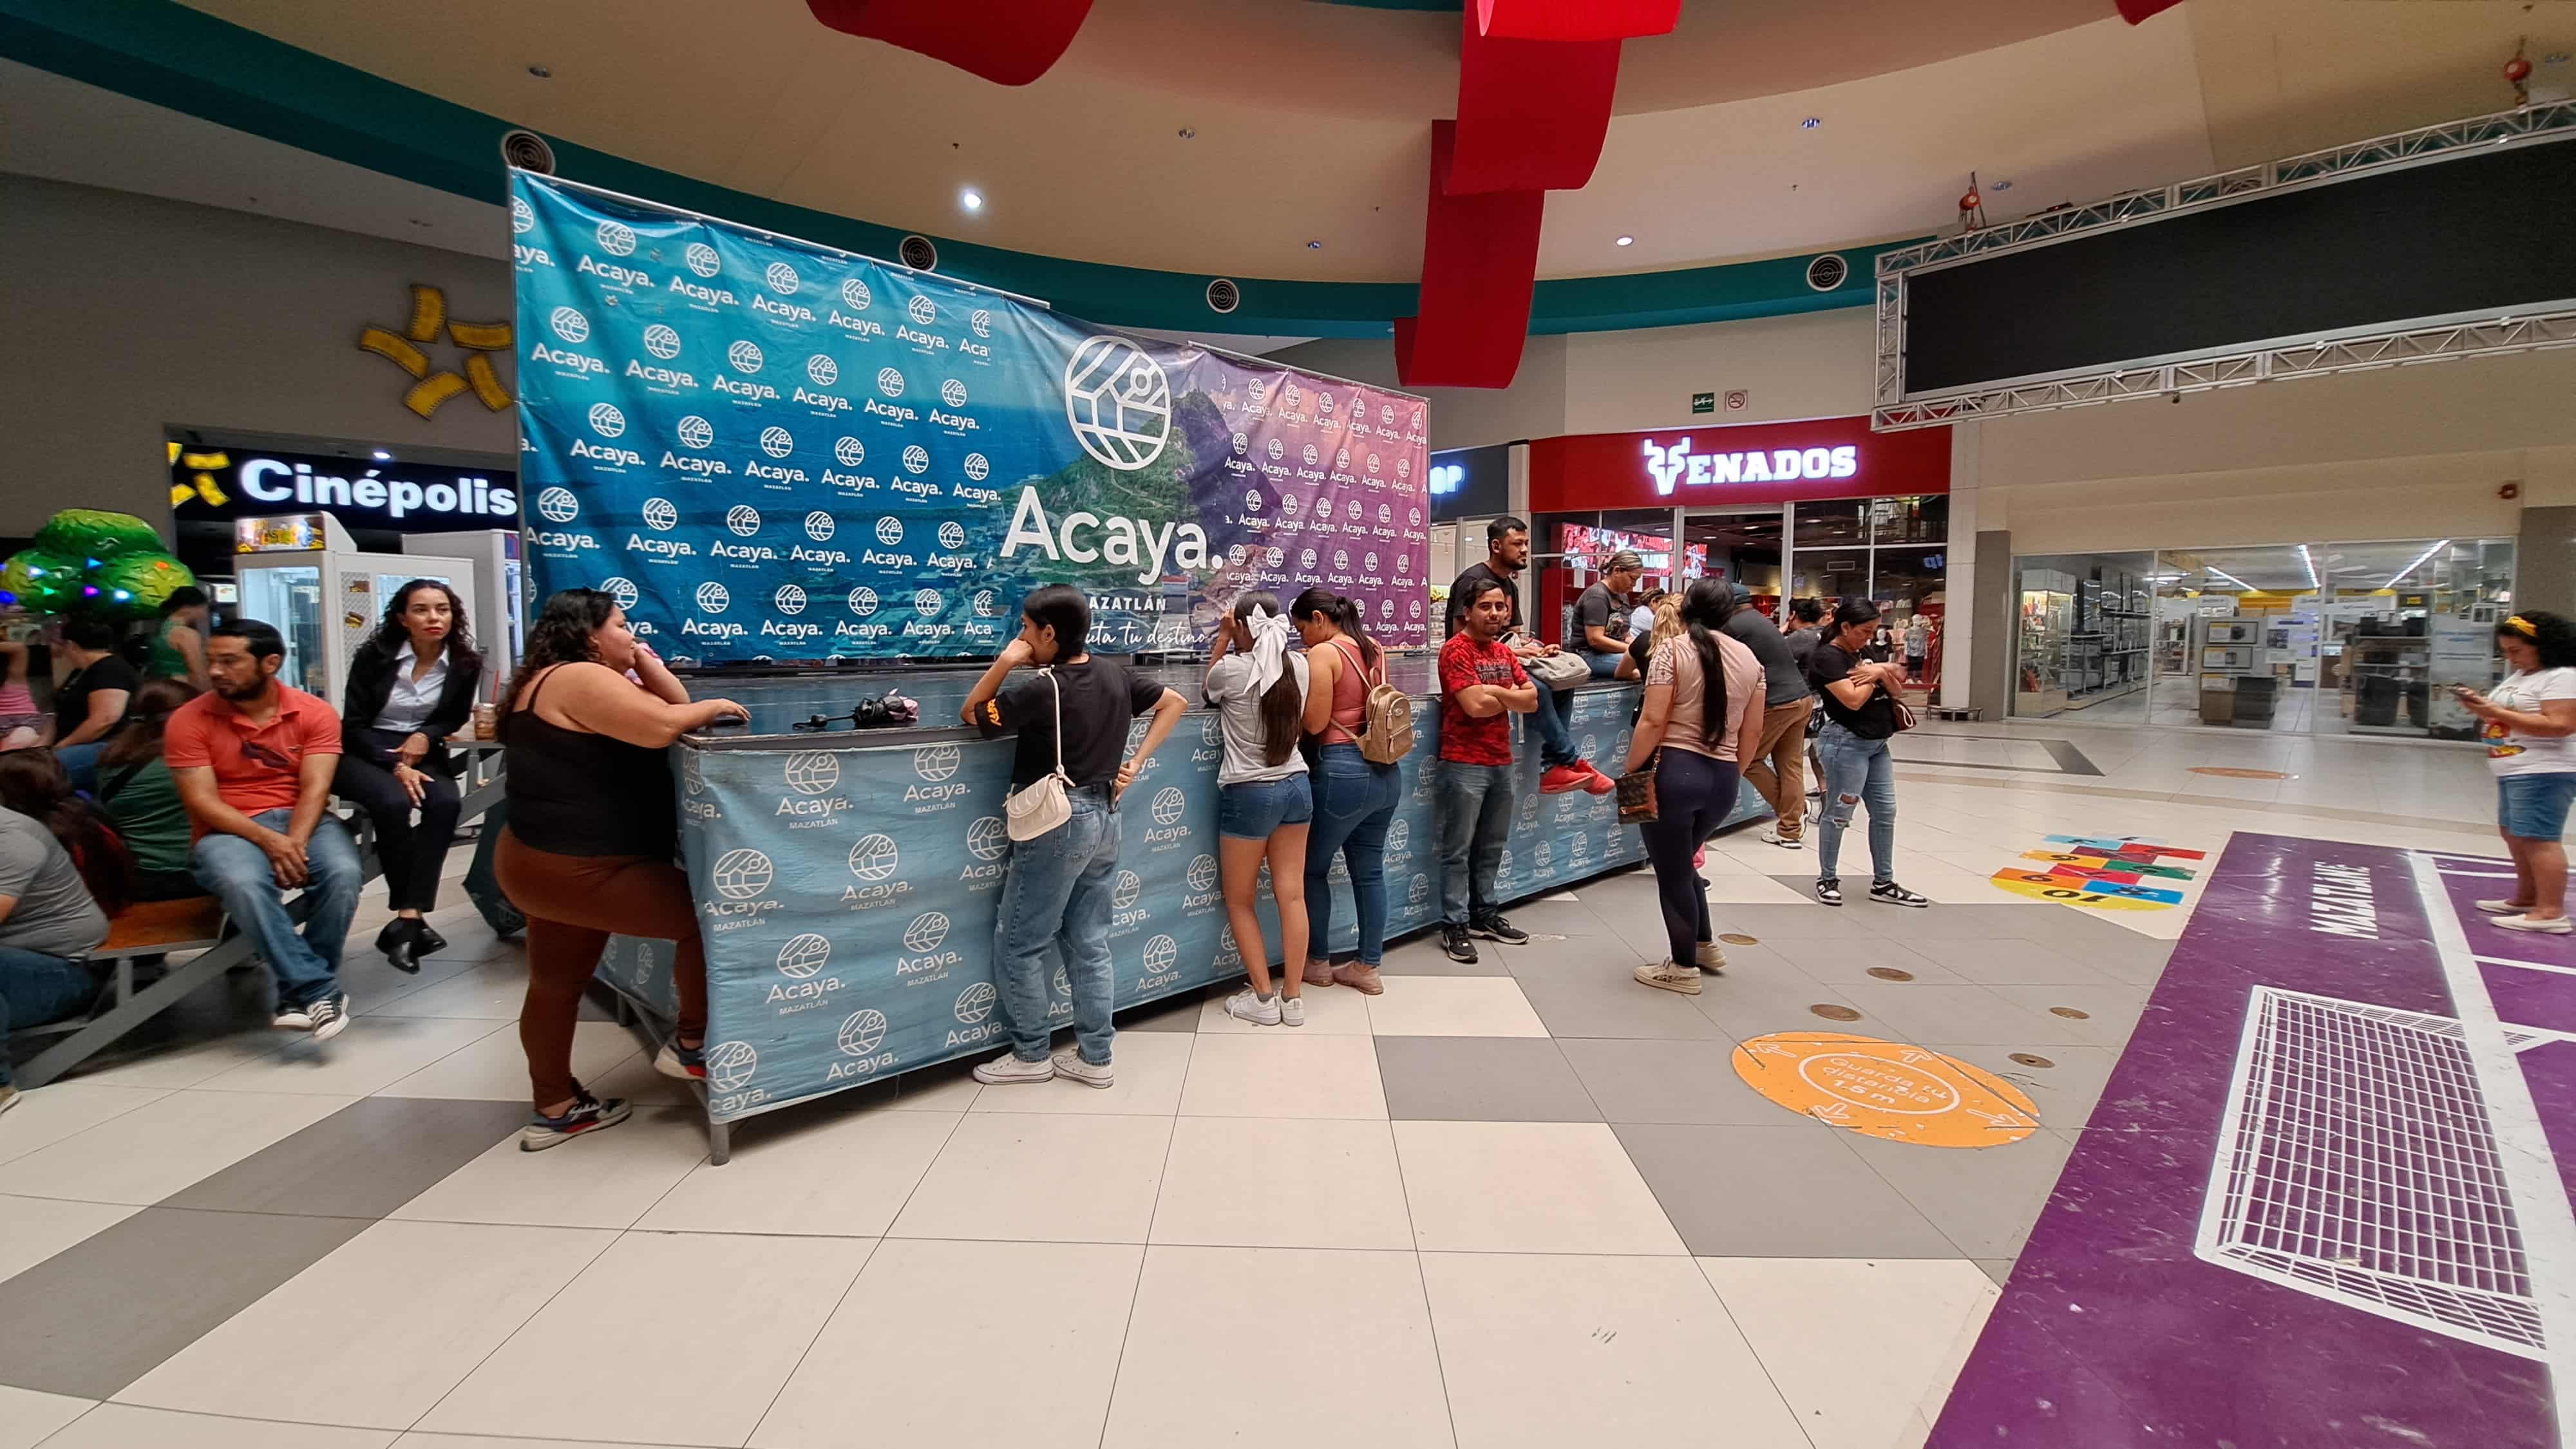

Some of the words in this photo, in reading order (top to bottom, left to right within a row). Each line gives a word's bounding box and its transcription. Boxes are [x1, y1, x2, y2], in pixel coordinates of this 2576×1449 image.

[577, 254, 655, 287] Acaya.
[670, 276, 739, 306] Acaya.
[752, 294, 817, 321] Acaya.
[828, 310, 885, 336] Acaya.
[896, 325, 949, 349] Acaya.
[532, 343, 611, 374] Acaya.
[959, 338, 989, 361] Aca
[626, 359, 699, 388] Acaya.
[712, 375, 781, 400] Acaya.
[793, 386, 853, 411] Acaya.
[864, 398, 918, 421] Acaya.
[1242, 402, 1272, 417] Acaya.
[1279, 408, 1308, 423] Acaya.
[929, 409, 980, 430] Acaya.
[1313, 414, 1341, 428] Acaya.
[1376, 426, 1400, 439] Acaya.
[570, 439, 646, 466] Acaya.
[660, 451, 732, 476] Acaya.
[744, 460, 810, 484] Acaya.
[1225, 457, 1255, 473] Acaya.
[1262, 461, 1291, 477] Acaya.
[1644, 437, 1856, 496] VENADOS
[822, 469, 880, 490] Acaya.
[1297, 467, 1327, 481] Acaya.
[1330, 471, 1356, 485] Acaya.
[1361, 476, 1386, 489] Acaya.
[240, 459, 518, 516] Cinépolis
[891, 476, 943, 496] Acaya.
[953, 483, 1001, 502] Acaya.
[1392, 482, 1415, 493] Acaya.
[1239, 514, 1270, 529] Acaya.
[1275, 518, 1305, 531] Acaya.
[1310, 520, 1337, 534] Acaya.
[1342, 524, 1368, 535] Acaya.
[999, 486, 1223, 585] Acaya.
[1372, 527, 1396, 538] Acaya.
[1403, 529, 1426, 541] Acaya.
[626, 534, 697, 556] Acaya.
[710, 540, 777, 562] Acaya.
[790, 545, 850, 565] Acaya.
[862, 549, 917, 568] Acaya.
[927, 553, 977, 571] Acaya.
[1260, 571, 1288, 583] Acaya.
[1295, 572, 1323, 585] Acaya.
[1328, 573, 1354, 585] Acaya.
[1359, 574, 1383, 586] Acaya.
[1392, 576, 1414, 588] Acaya.
[682, 618, 748, 638] Acaya.
[761, 620, 822, 638] Acaya.
[835, 620, 892, 639] Acaya.
[903, 621, 954, 638] Acaya.
[965, 621, 993, 638] Aca
[1147, 621, 1208, 645] destino
[1376, 621, 1399, 633] Acaya.
[1404, 621, 1426, 632] Acaya.
[904, 782, 971, 802] Acaya.
[775, 797, 854, 816] Acaya.
[1144, 824, 1191, 842] Acaya.
[960, 864, 1010, 880] Acay
[840, 881, 913, 901] Acaya.
[896, 952, 962, 975] Acaya.
[766, 978, 845, 1003] Acaya.
[1135, 973, 1182, 992] Acaya.
[944, 1023, 1007, 1048] Acaya.
[826, 1050, 898, 1081] Acaya.
